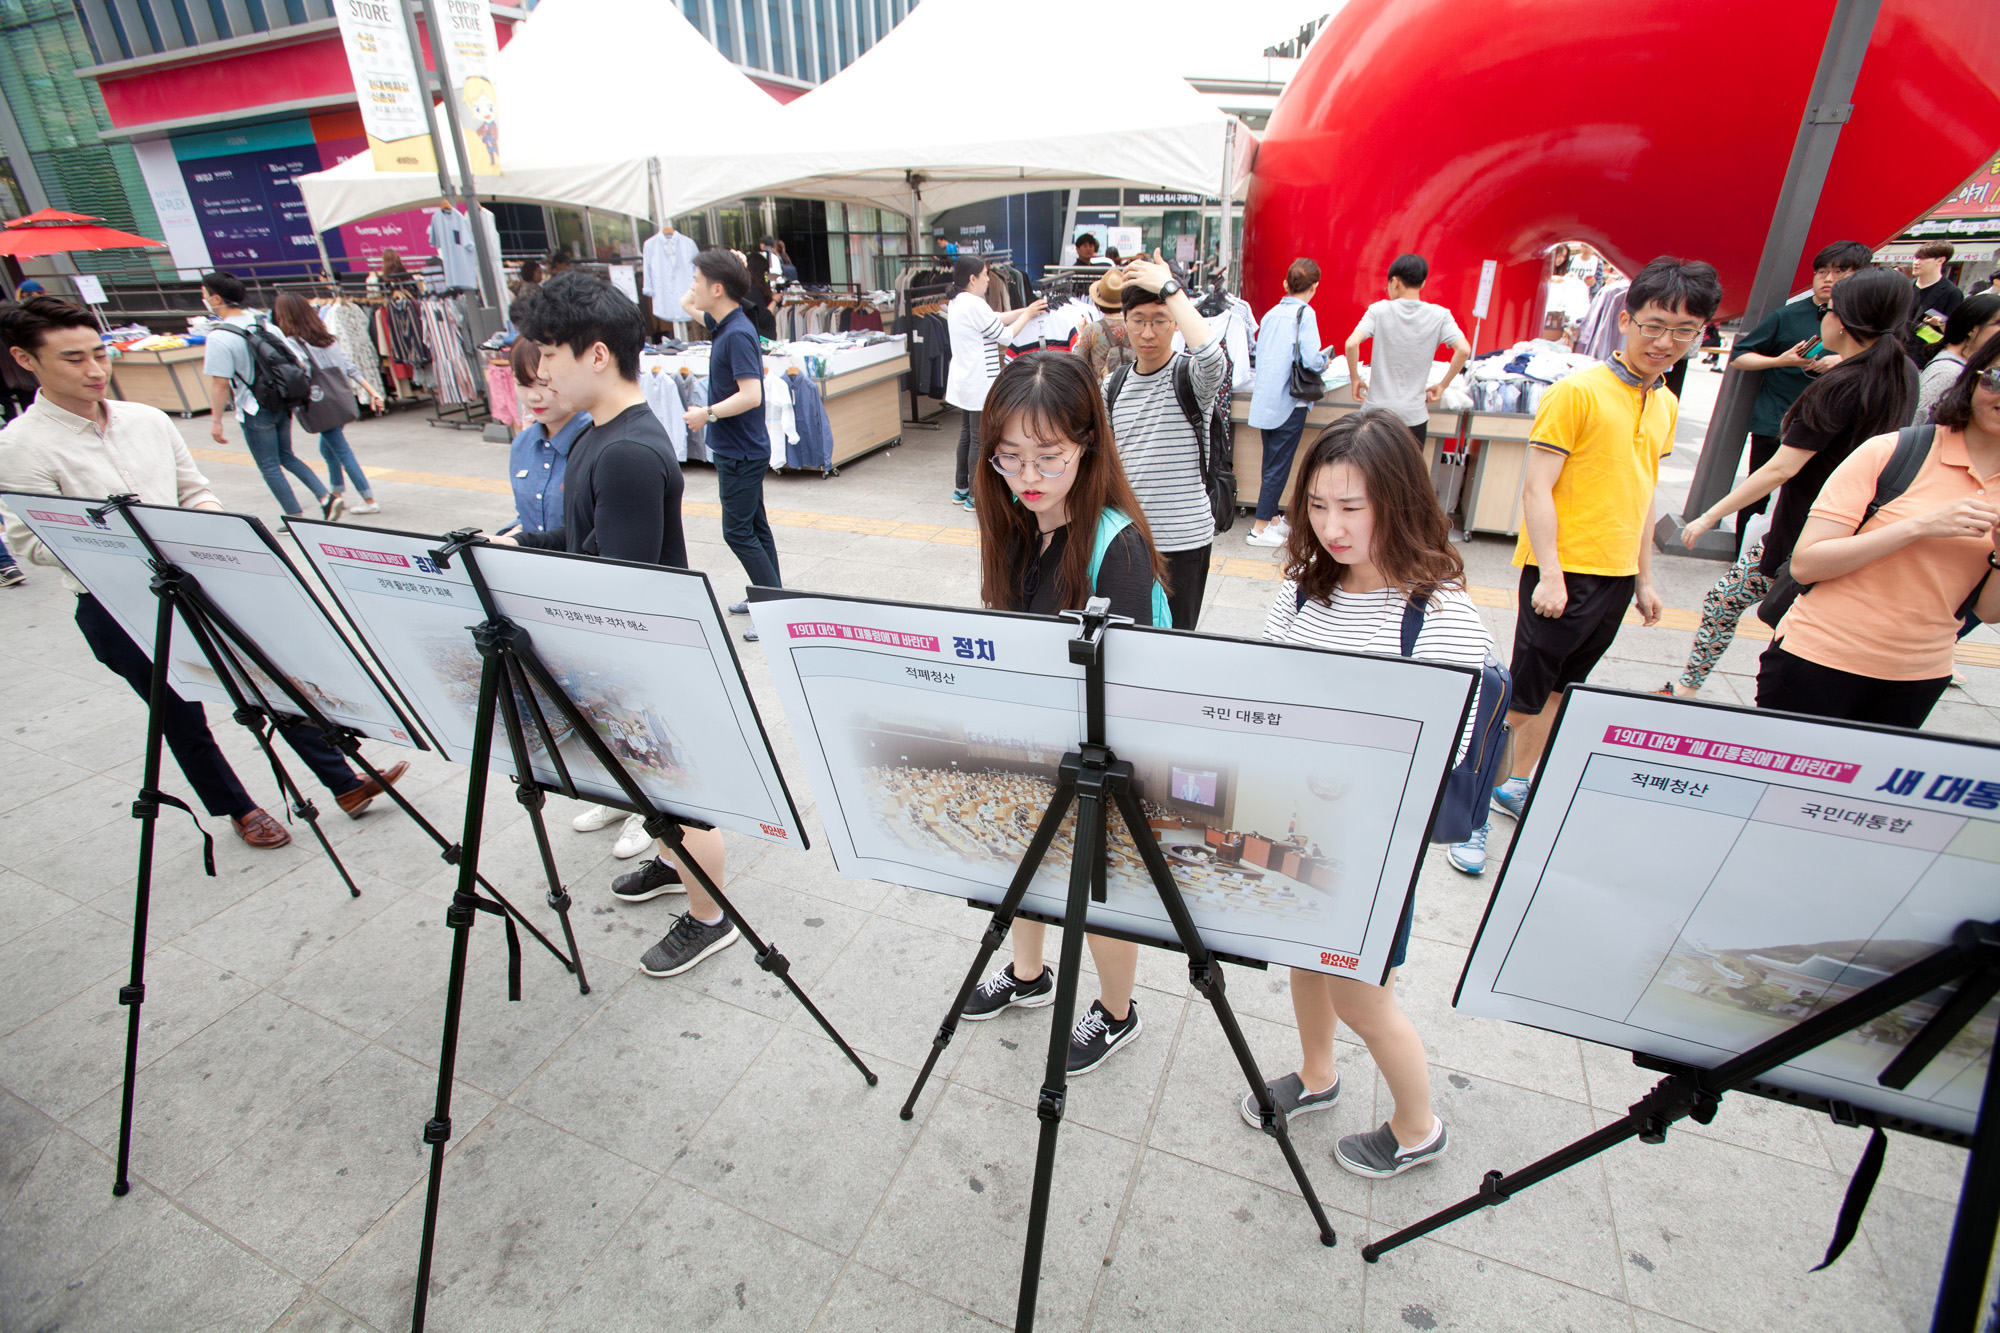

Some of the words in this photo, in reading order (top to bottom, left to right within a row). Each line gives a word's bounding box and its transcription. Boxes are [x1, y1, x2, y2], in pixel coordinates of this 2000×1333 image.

[349, 0, 391, 22] STORE
[412, 555, 443, 575] 경제
[393, 580, 418, 592] 활성화
[418, 584, 436, 595] 경기
[544, 607, 564, 619] 복지
[564, 610, 584, 622] 강화
[584, 613, 604, 625] 빈부
[605, 616, 626, 629] 격차
[626, 620, 648, 631] 해소
[792, 624, 816, 635] 19대
[816, 624, 837, 636] 대선
[853, 628, 901, 645] 대통령에게
[952, 636, 996, 661] 정치
[905, 666, 955, 685] 적폐청산
[1201, 705, 1231, 721] 국민
[1236, 710, 1282, 726] 대통합
[1614, 728, 1647, 746] 19대
[1648, 733, 1680, 751] 대선
[1708, 743, 1791, 770] 대통령에게
[1631, 772, 1710, 798] 적폐청산
[1875, 767, 1926, 796] 새
[1801, 803, 1913, 833] 국민대통합
[1320, 951, 1360, 971] 일요신문
